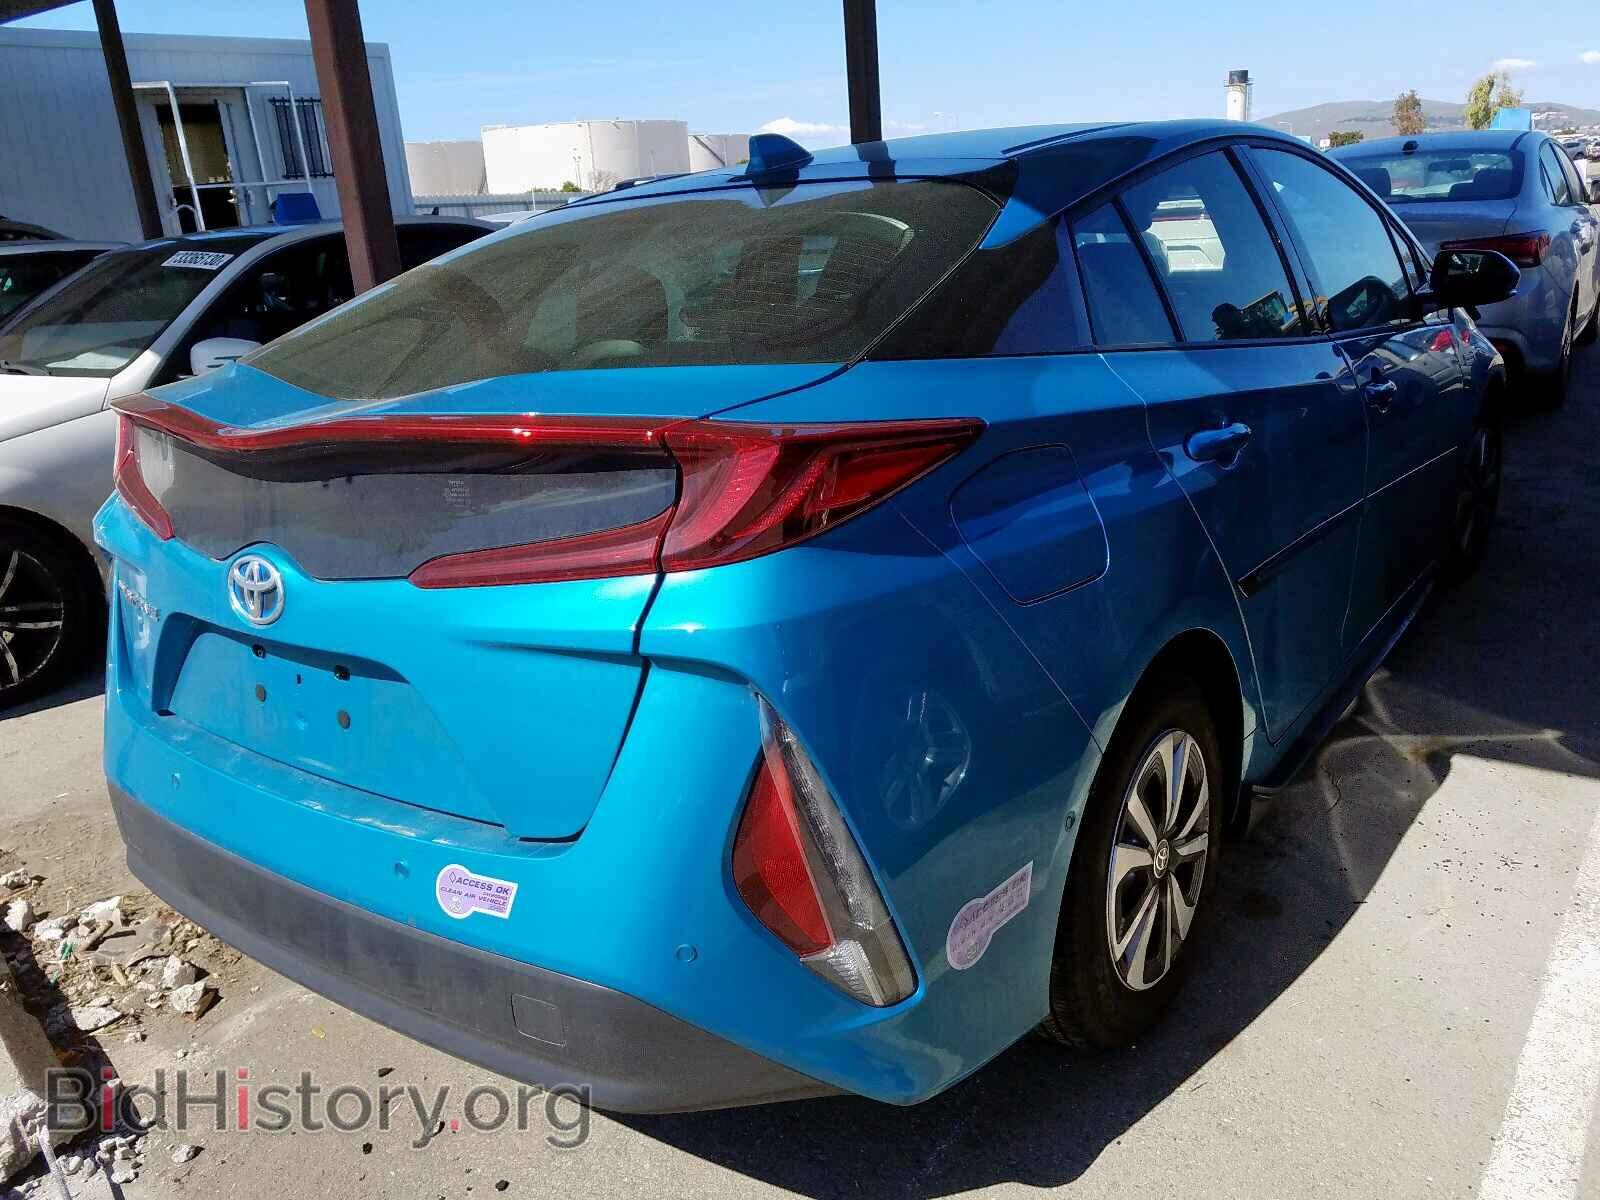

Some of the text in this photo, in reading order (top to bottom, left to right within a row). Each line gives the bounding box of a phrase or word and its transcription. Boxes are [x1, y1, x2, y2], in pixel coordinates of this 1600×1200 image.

[455, 877, 510, 895] ACCESS OK
[440, 886, 463, 896] CLEAN
[478, 895, 507, 906] VEHICLE
